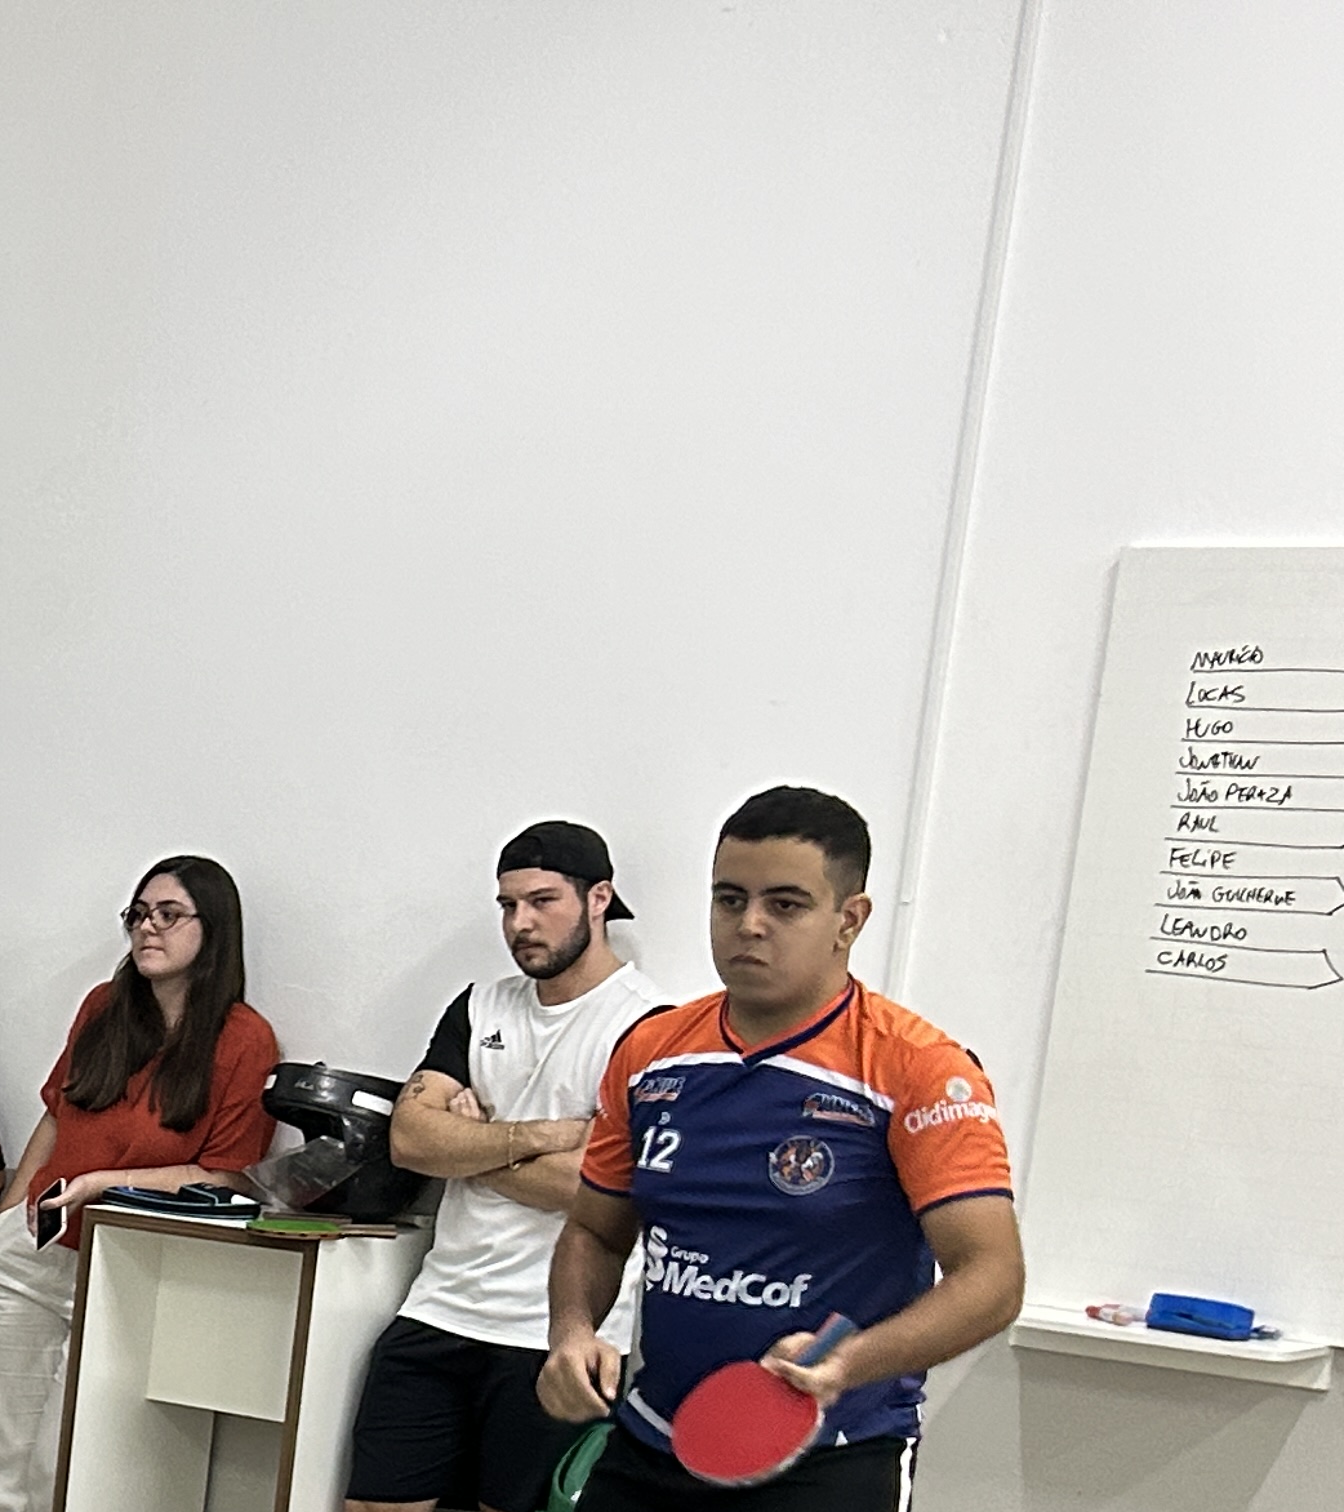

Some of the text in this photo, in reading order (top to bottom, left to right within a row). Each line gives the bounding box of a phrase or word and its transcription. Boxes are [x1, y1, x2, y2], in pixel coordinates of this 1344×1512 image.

[1186, 718, 1233, 738] HUGO
[1177, 812, 1219, 833] RAUL
[1160, 913, 1247, 941] LEANDRO
[1157, 949, 1229, 973] CARLOS
[637, 1125, 682, 1173] 12
[670, 1246, 709, 1264] Grupo
[662, 1261, 812, 1307] MedCof
